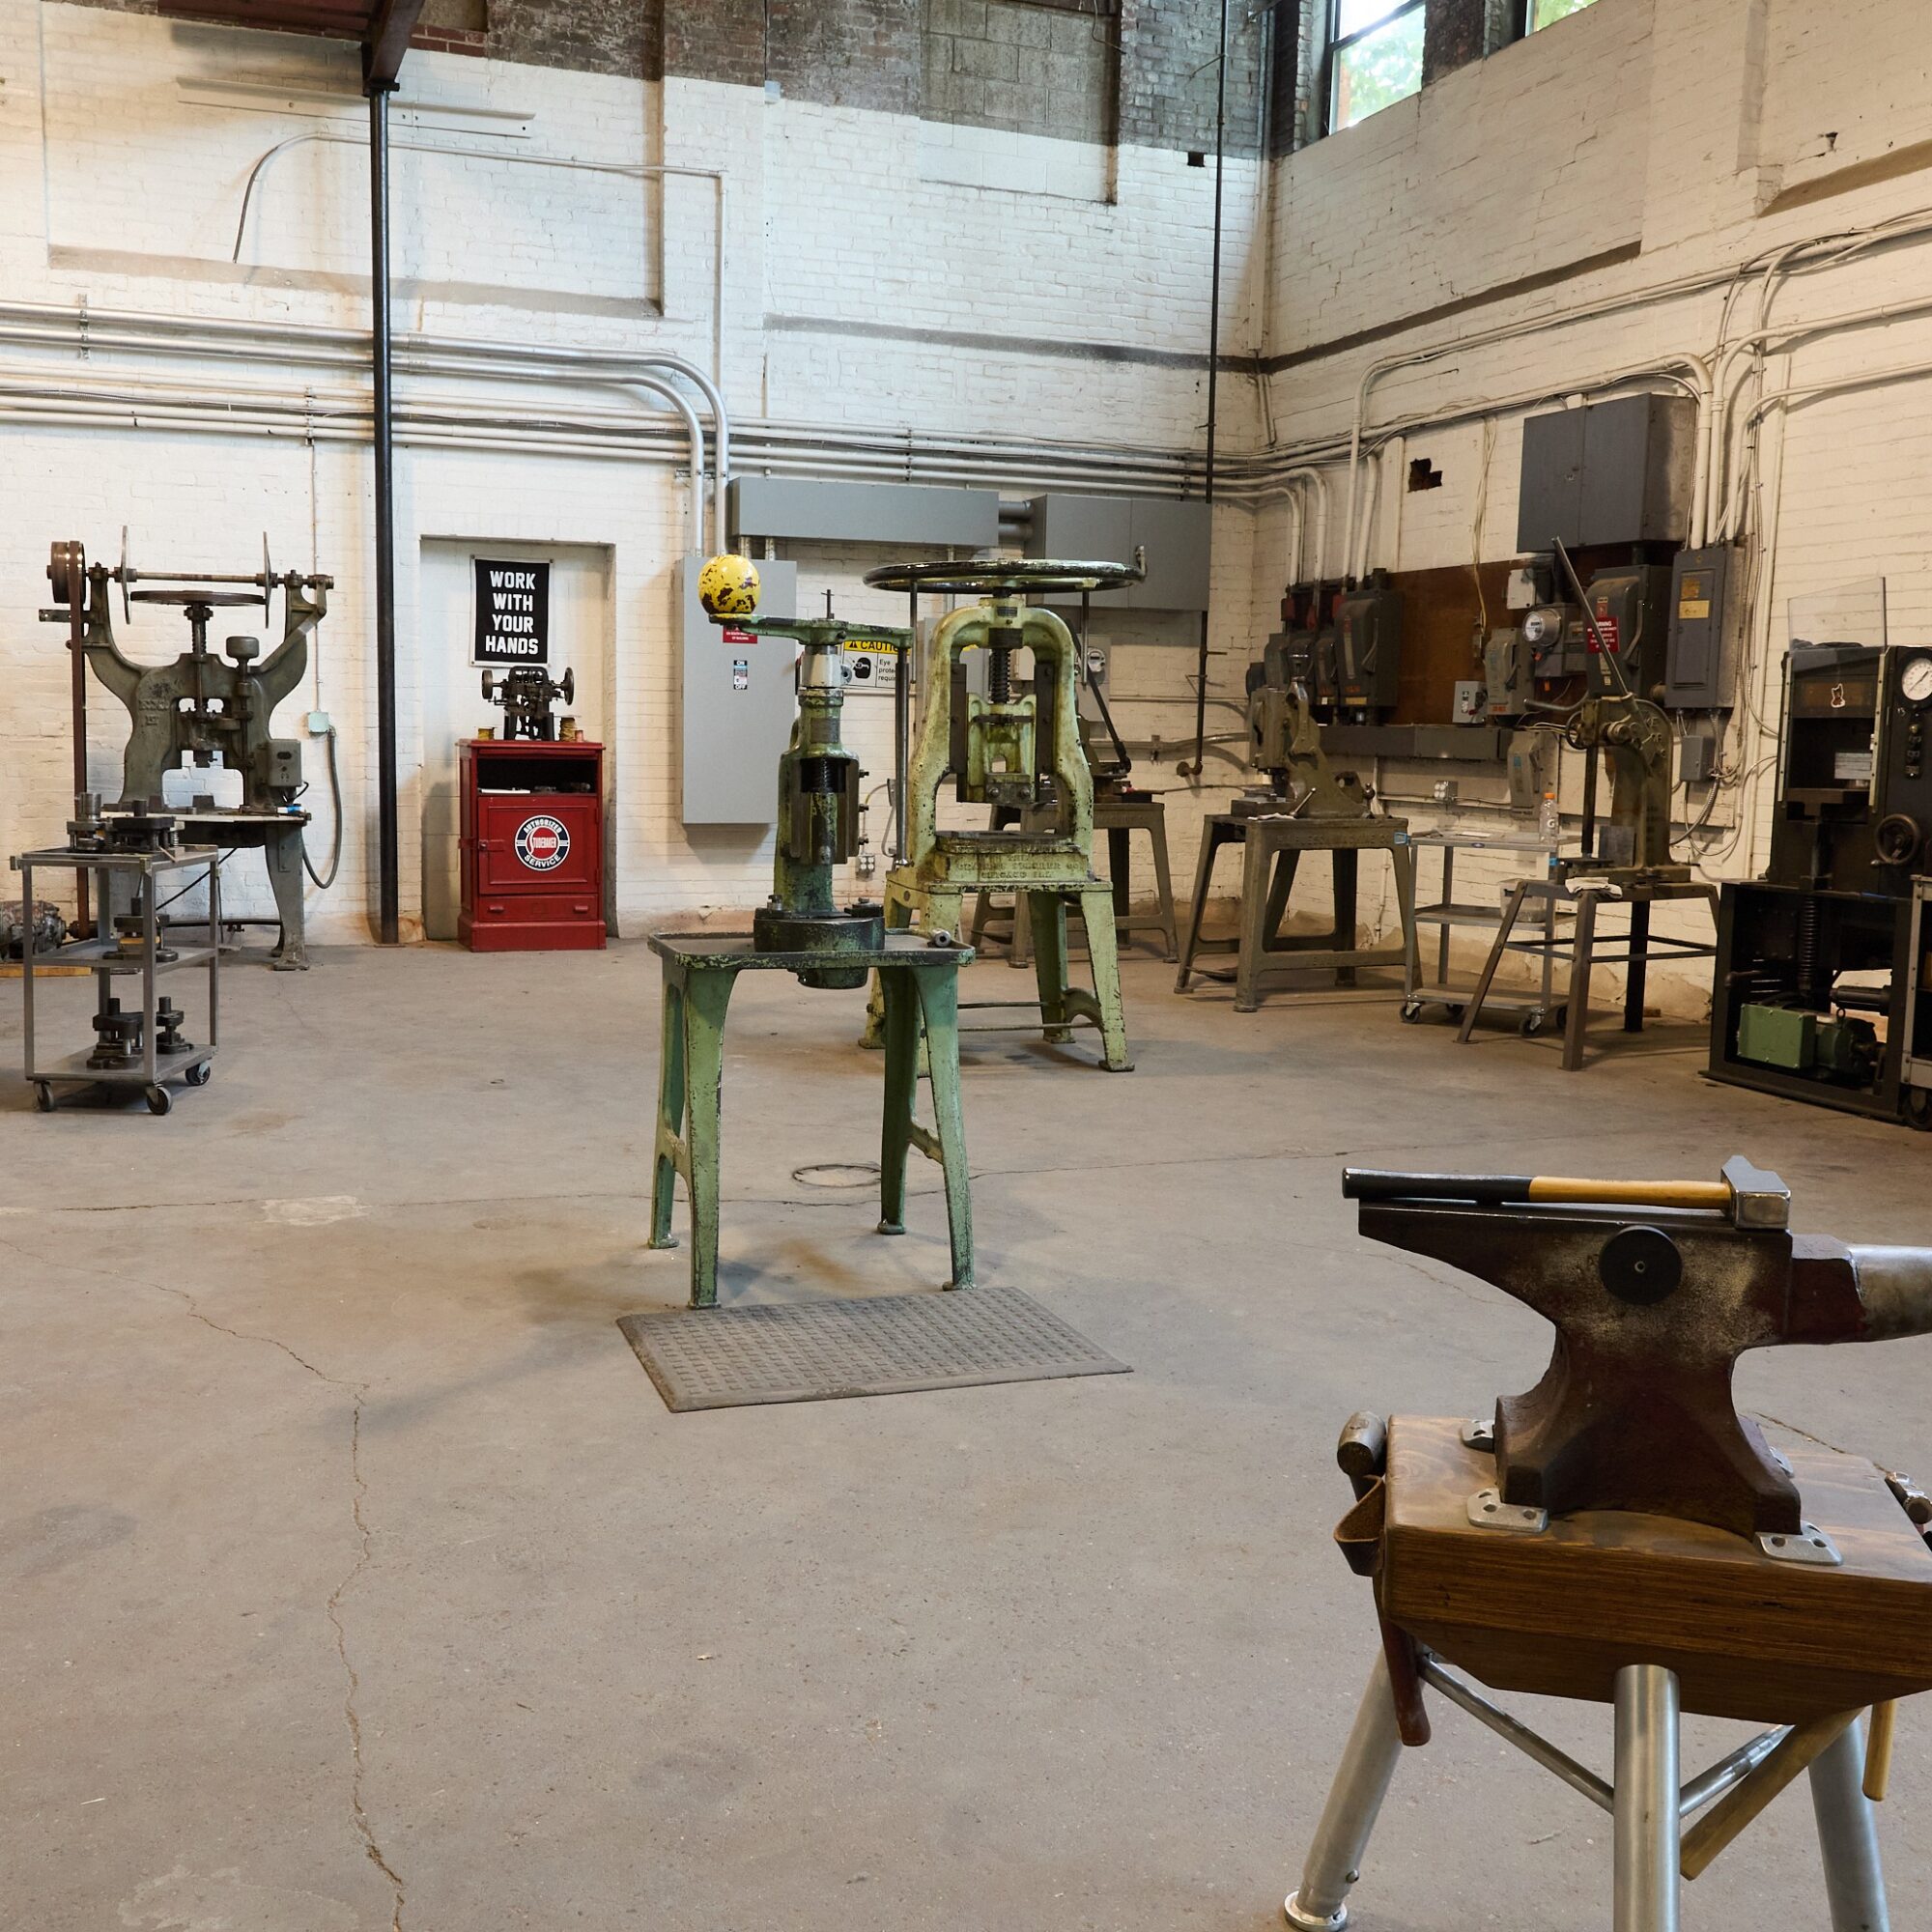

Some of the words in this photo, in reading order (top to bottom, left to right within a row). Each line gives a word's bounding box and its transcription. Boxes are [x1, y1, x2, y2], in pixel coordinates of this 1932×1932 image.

[489, 570, 536, 590] WORK
[493, 592, 533, 611] WITH
[492, 613, 534, 633] YOUR
[485, 635, 539, 655] HANDS
[861, 640, 907, 652] CAUTI
[523, 818, 563, 834] AUTHORIZED
[524, 854, 561, 867] SERVICE
